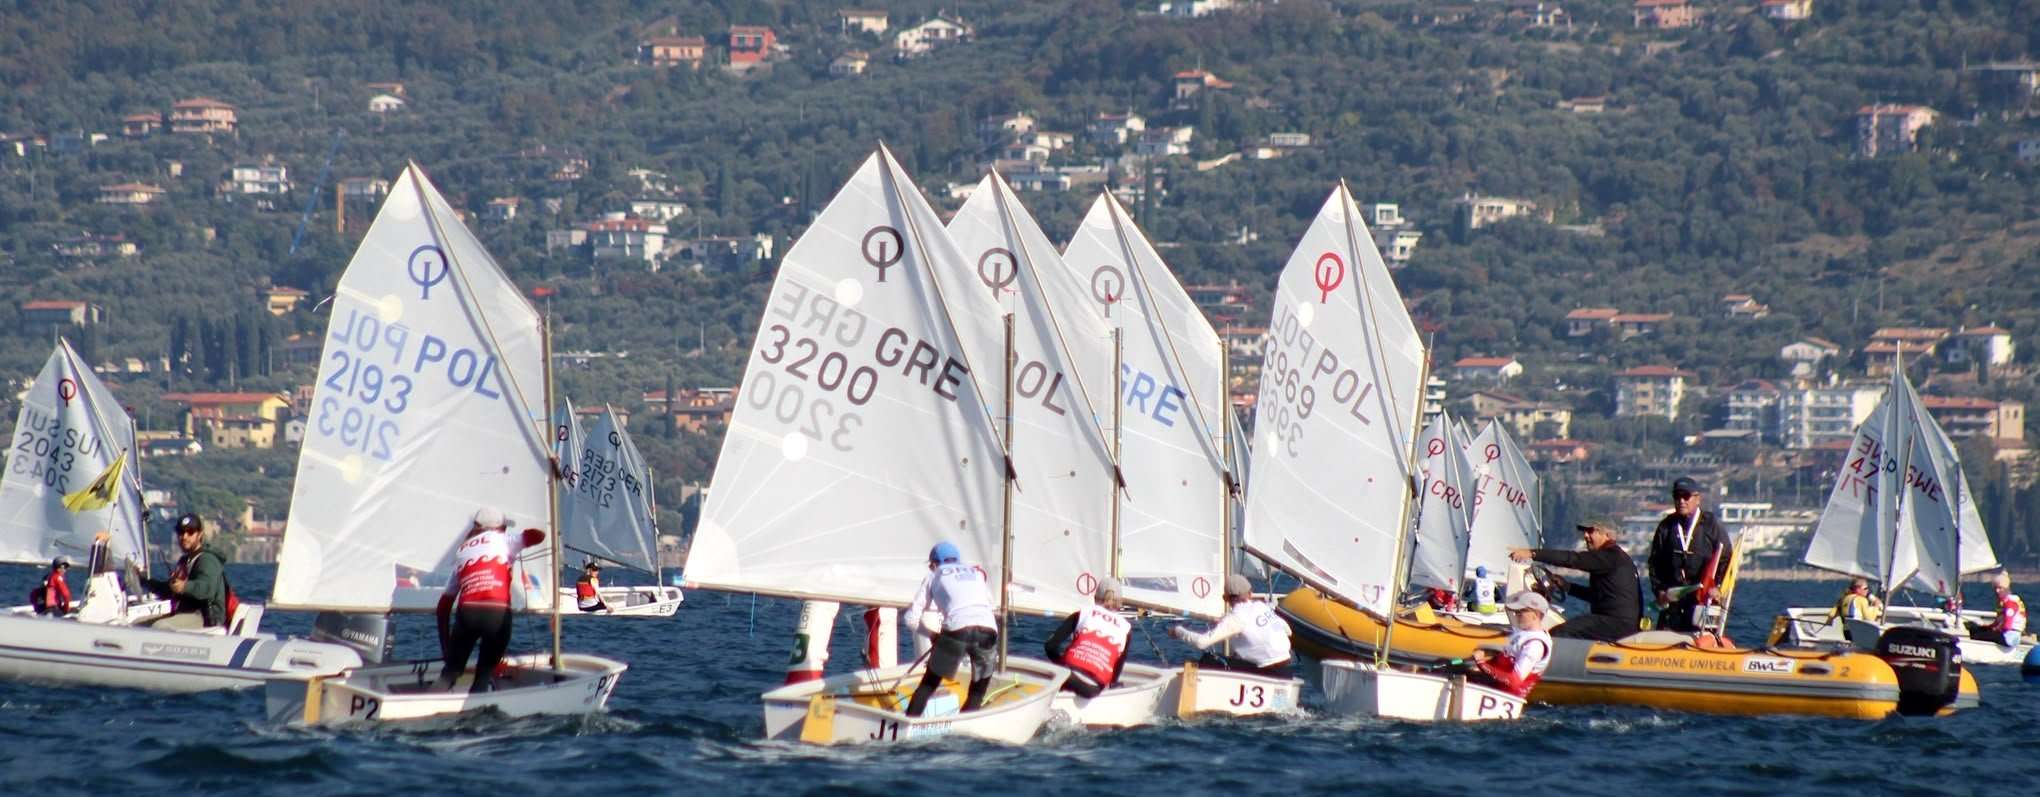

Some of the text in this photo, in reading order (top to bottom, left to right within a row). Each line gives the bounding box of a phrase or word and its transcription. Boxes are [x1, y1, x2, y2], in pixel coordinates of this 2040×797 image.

[414, 335, 501, 400] POL
[760, 324, 879, 406] 3200
[875, 327, 969, 402] GRE
[1266, 335, 1316, 420] 3969
[325, 350, 413, 414] 2193
[1013, 351, 1066, 417] OL
[1312, 348, 1373, 426] POL
[16, 431, 75, 473] 2043
[64, 428, 101, 459] SUI
[582, 463, 616, 492] 2173
[1906, 464, 1943, 503] SWE
[1497, 481, 1528, 509] TUR
[350, 629, 379, 647] YAMAHA
[1888, 643, 1937, 659] SUZUKI
[1630, 655, 1736, 672] CAMPIONE UNIVELA
[1747, 660, 1777, 672] BWA
[1839, 666, 1850, 678] 2
[350, 695, 380, 720] P2
[1229, 684, 1265, 708] J3
[1478, 694, 1515, 720] P3
[869, 719, 899, 741] J1
